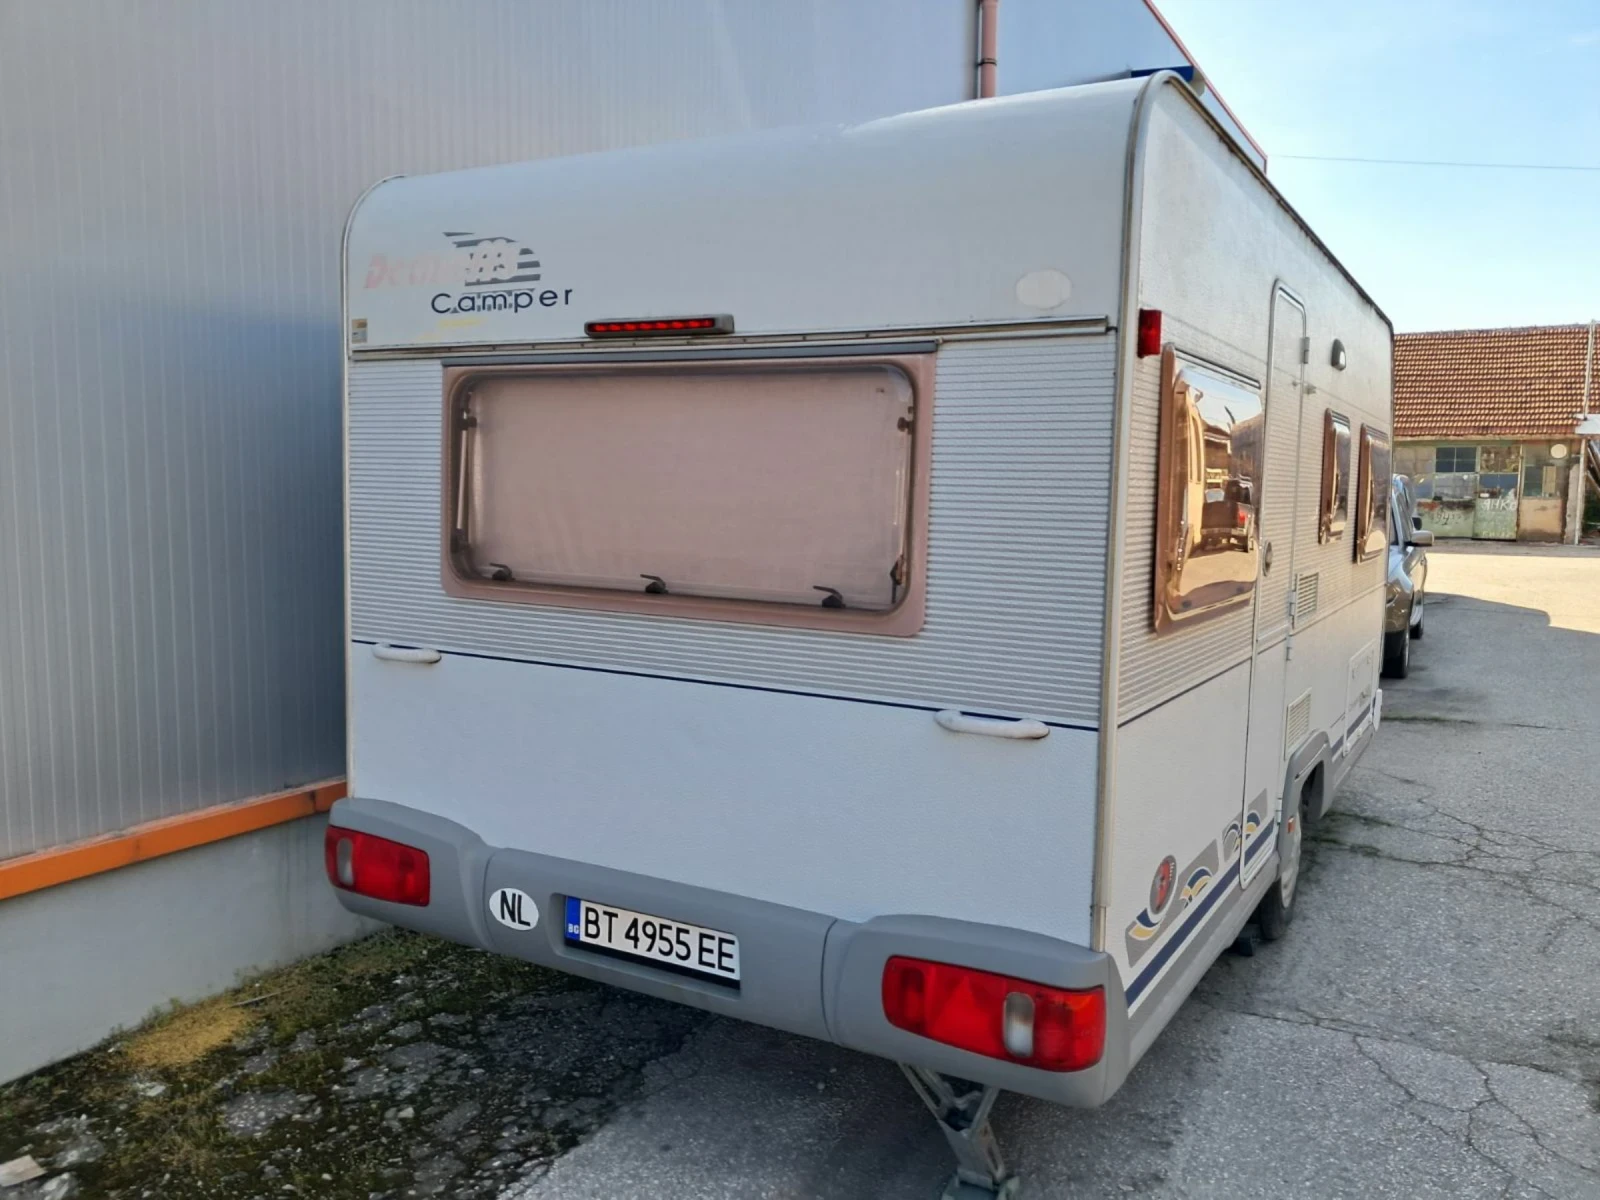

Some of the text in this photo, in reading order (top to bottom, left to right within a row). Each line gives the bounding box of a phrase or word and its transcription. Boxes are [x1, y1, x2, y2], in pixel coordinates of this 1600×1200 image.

[431, 287, 572, 313] Camper
[500, 890, 531, 927] NL
[568, 923, 580, 935] BG
[584, 906, 736, 974] BT 4955 EE
